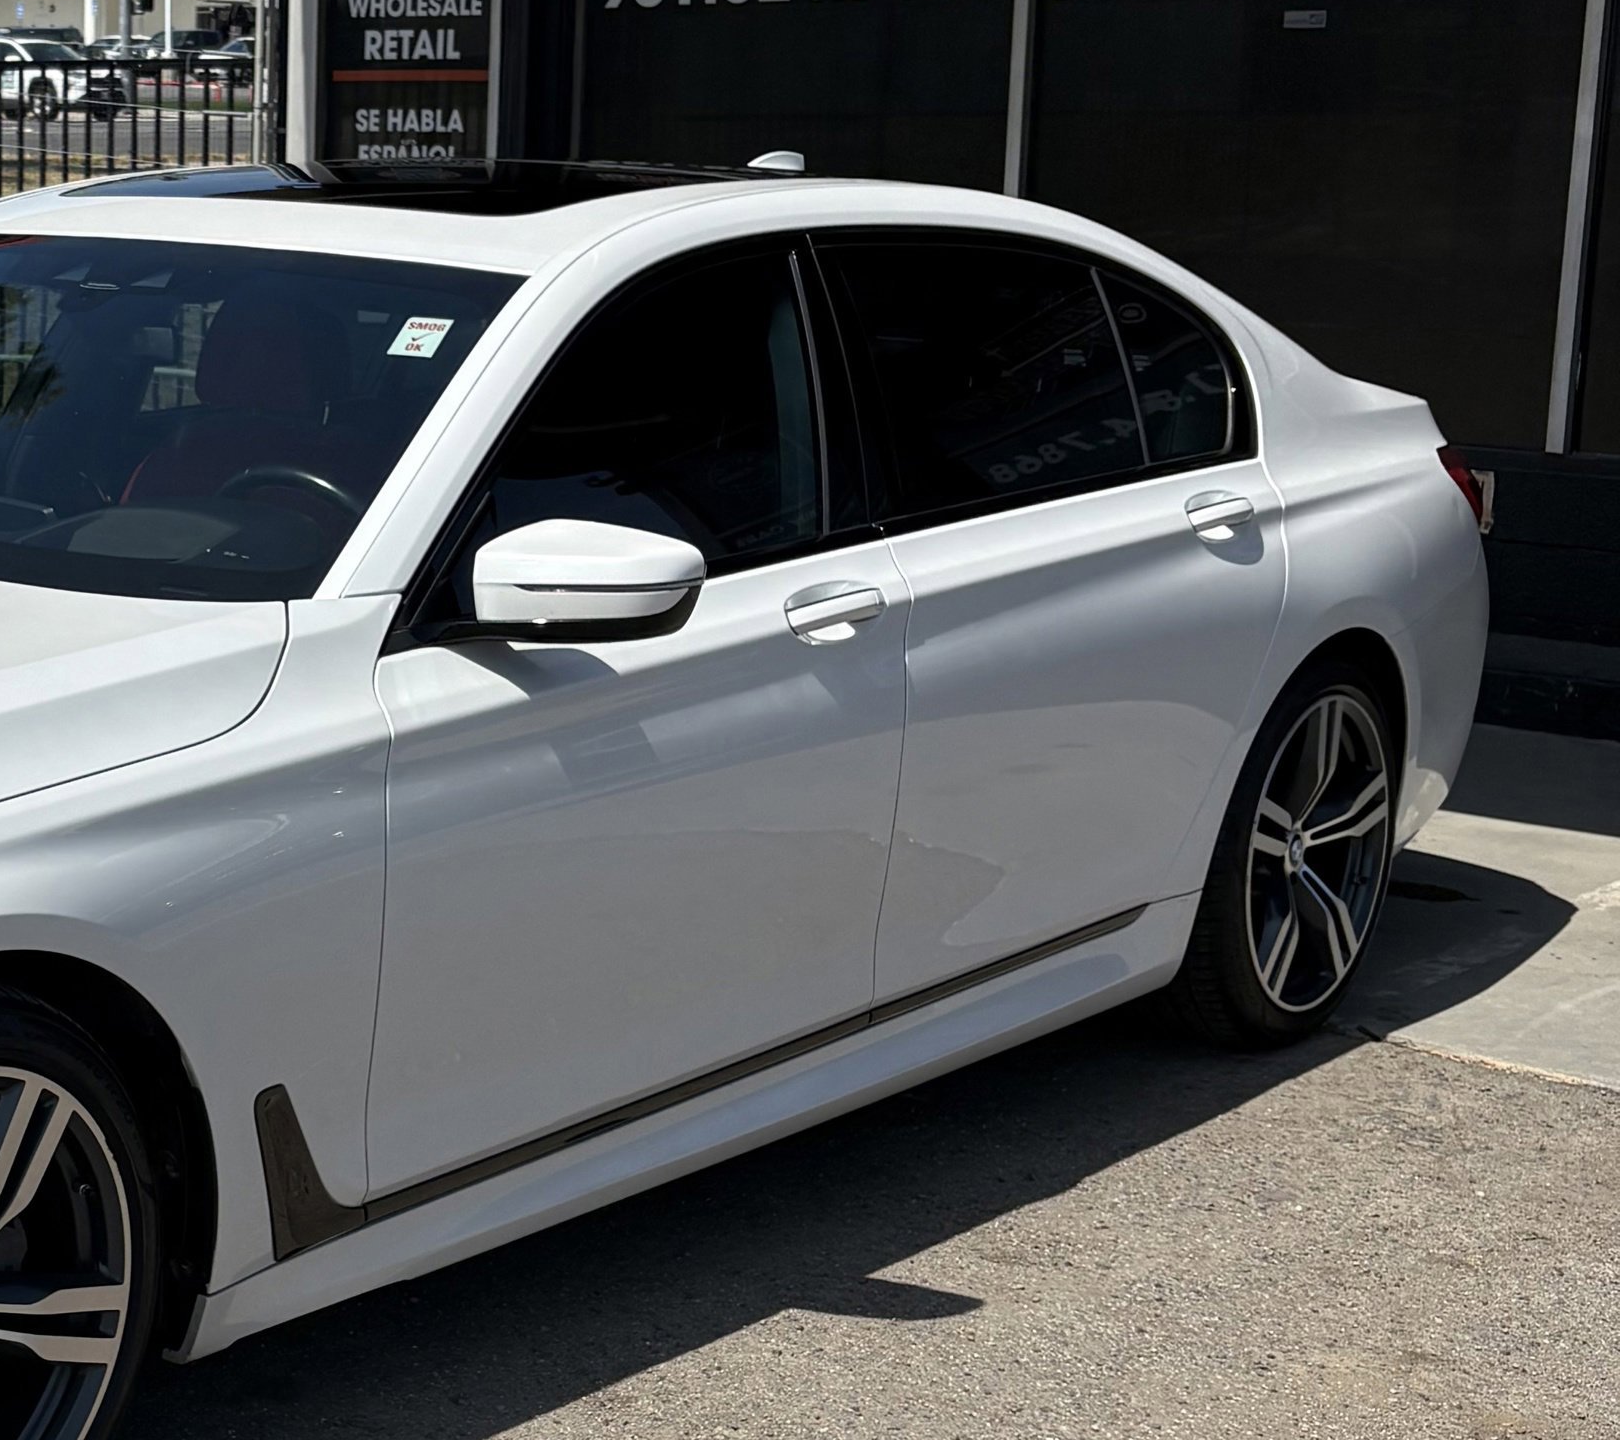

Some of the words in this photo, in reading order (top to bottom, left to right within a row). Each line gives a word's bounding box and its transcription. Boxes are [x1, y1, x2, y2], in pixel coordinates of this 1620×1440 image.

[364, 28, 461, 61] RETAIL
[355, 108, 380, 133] SE
[386, 108, 465, 133] HABLA
[408, 321, 447, 331] SMOG
[405, 342, 424, 352] OK
